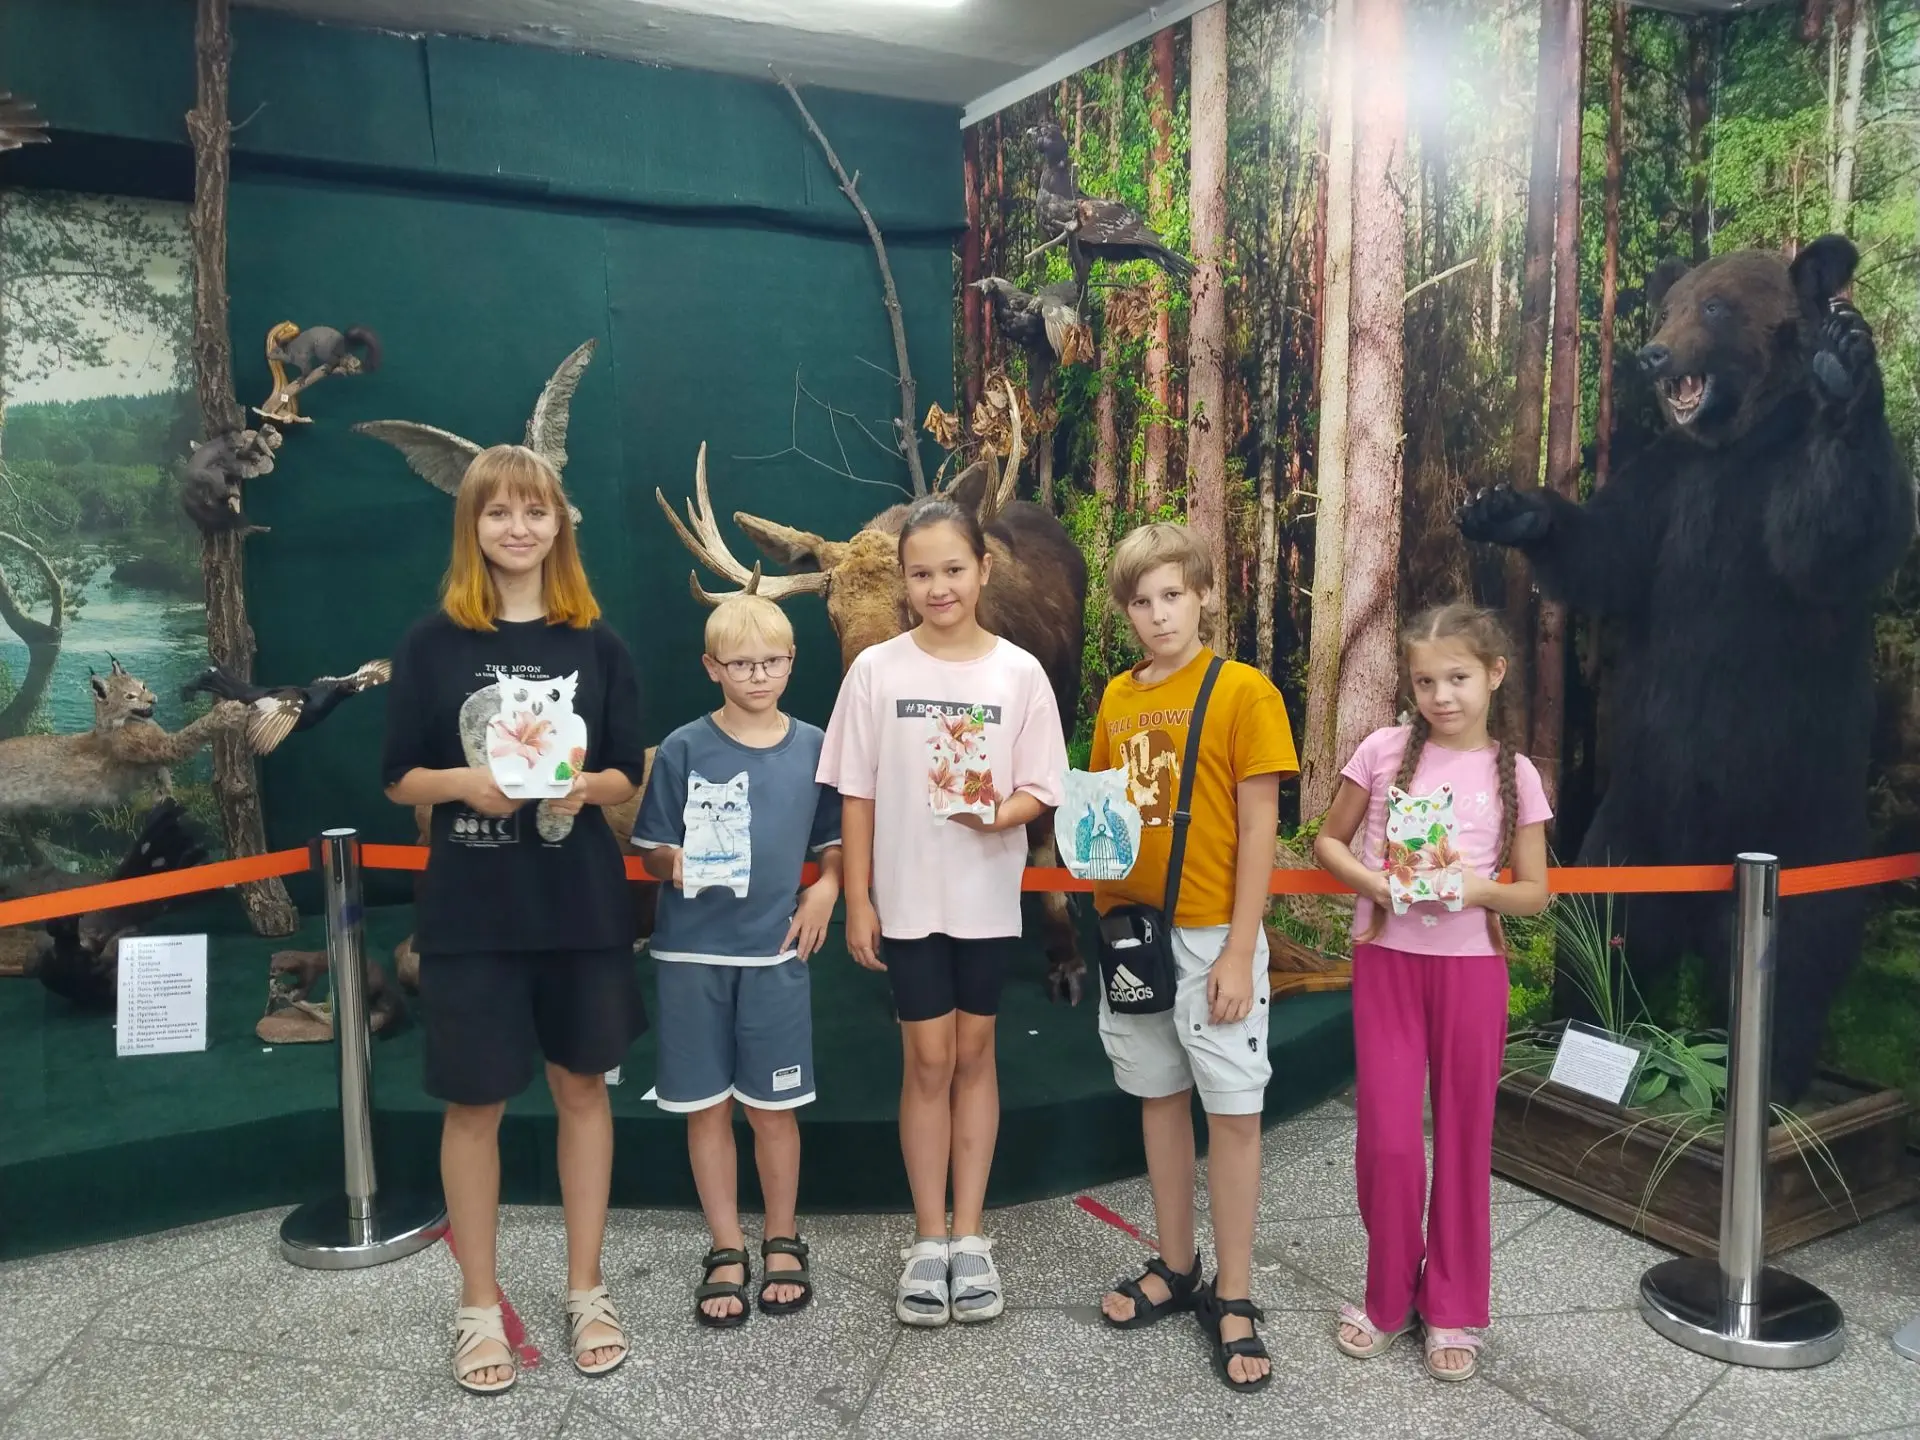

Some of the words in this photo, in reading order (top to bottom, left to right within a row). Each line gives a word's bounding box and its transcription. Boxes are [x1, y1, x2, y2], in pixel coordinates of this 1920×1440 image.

[485, 664, 508, 673] THE
[511, 665, 542, 674] MOON
[1109, 986, 1154, 1002] adidas
